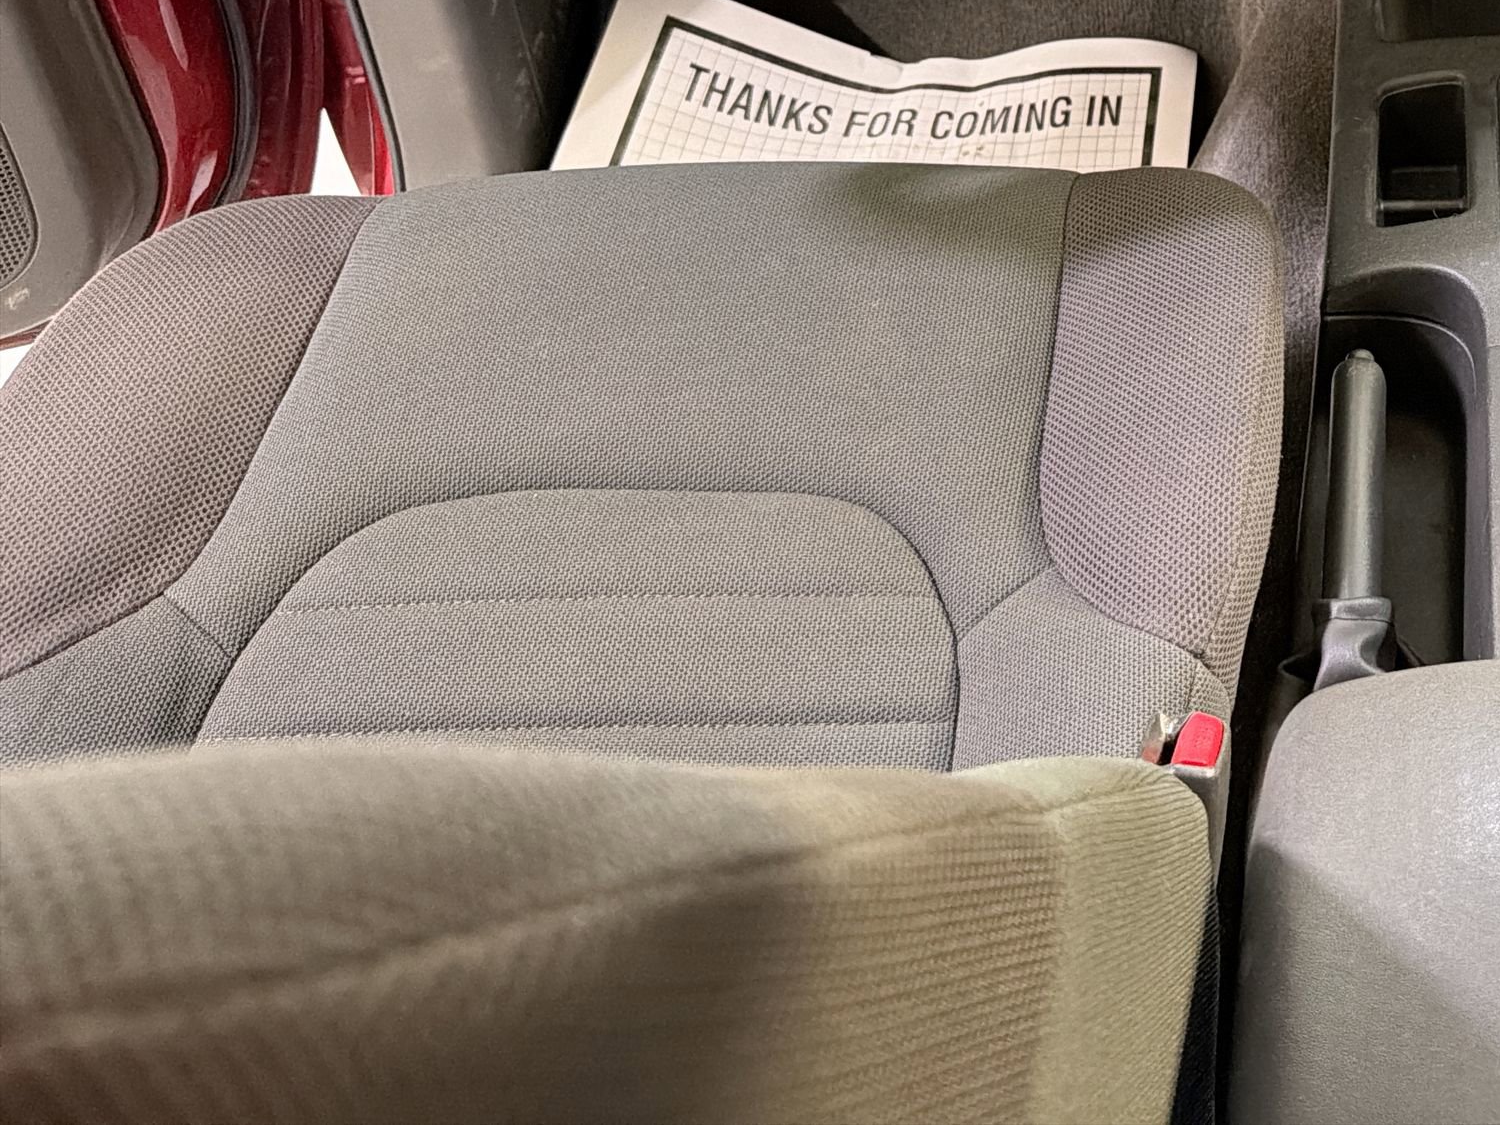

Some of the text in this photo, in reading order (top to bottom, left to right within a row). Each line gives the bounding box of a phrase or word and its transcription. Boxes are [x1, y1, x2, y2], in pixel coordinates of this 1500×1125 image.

[684, 62, 1123, 139] THANKS FOR COMING IN
